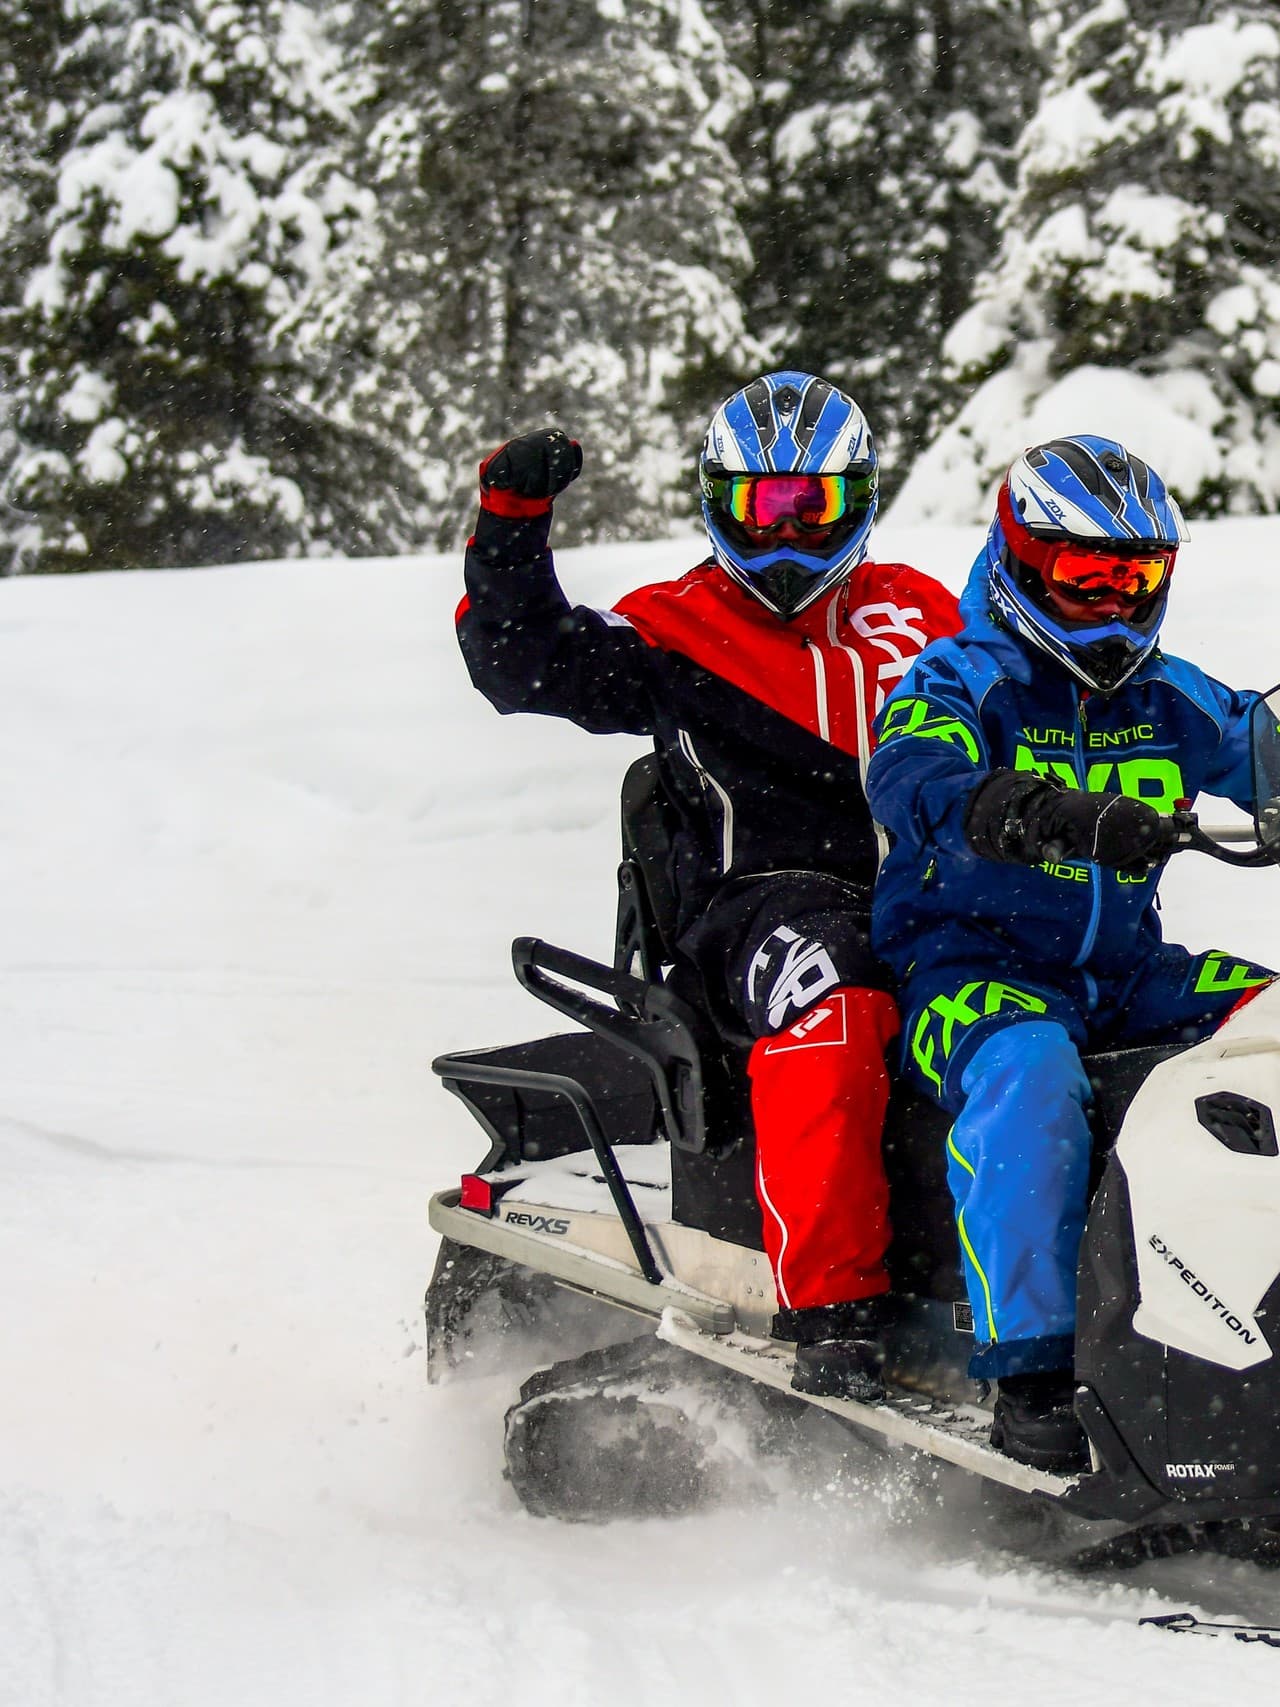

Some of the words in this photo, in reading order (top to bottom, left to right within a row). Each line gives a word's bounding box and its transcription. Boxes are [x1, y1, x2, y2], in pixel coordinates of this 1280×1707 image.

[1045, 499, 1067, 521] ZOX
[912, 981, 1047, 1098] FXR
[1149, 1235, 1257, 1345] EXPEDITION
[1166, 1463, 1216, 1478] ROTAX
[1214, 1463, 1235, 1471] POWER
